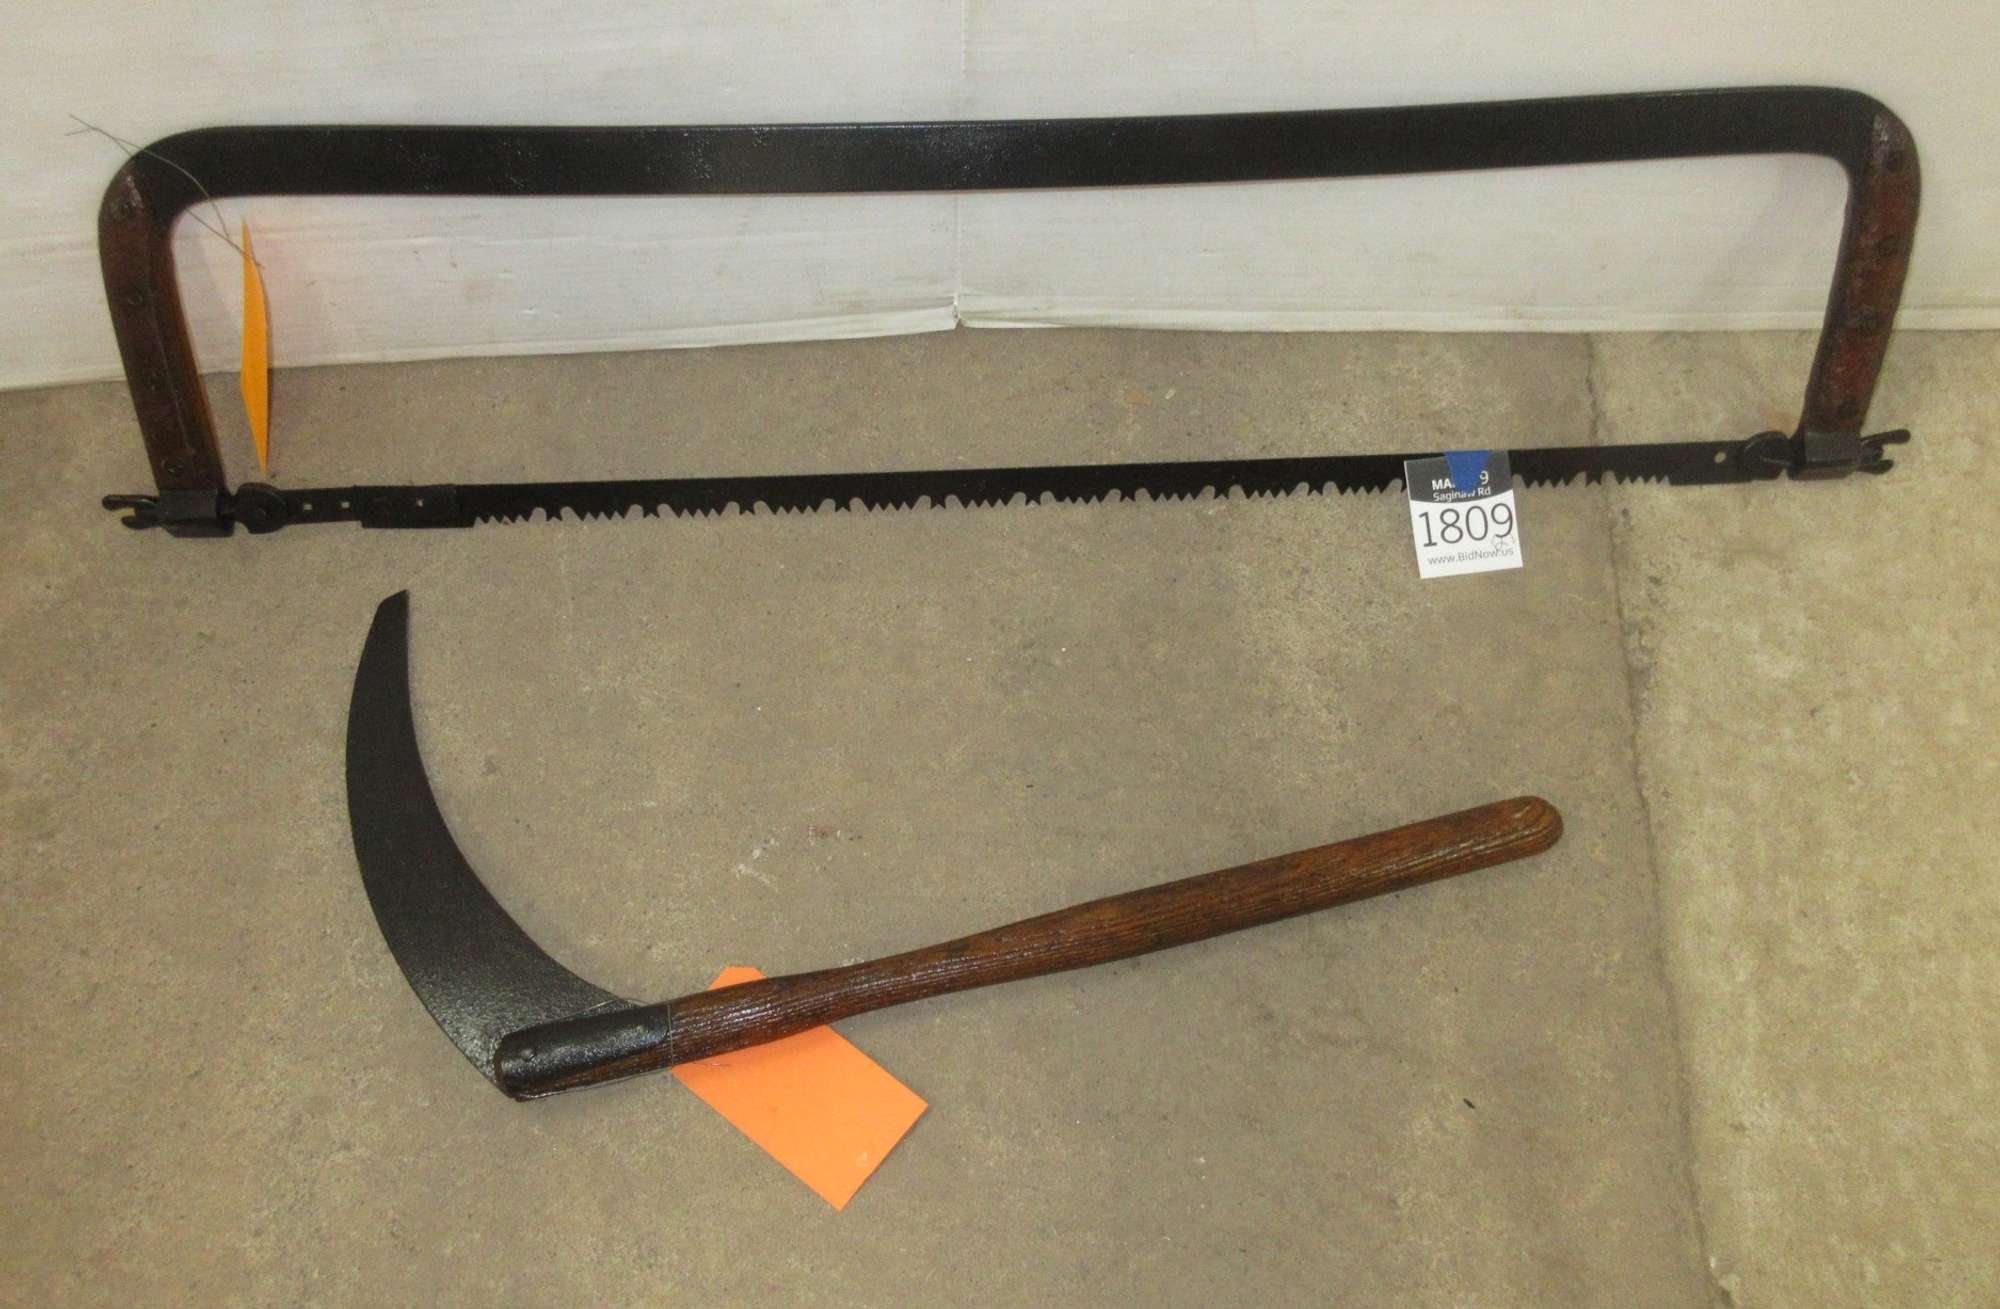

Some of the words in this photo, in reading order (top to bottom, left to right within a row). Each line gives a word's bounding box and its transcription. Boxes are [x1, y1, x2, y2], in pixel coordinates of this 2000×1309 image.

[1477, 486, 1491, 496] Rd
[1418, 502, 1513, 547] 1809
[1427, 548, 1514, 565] www.BidNow.us
